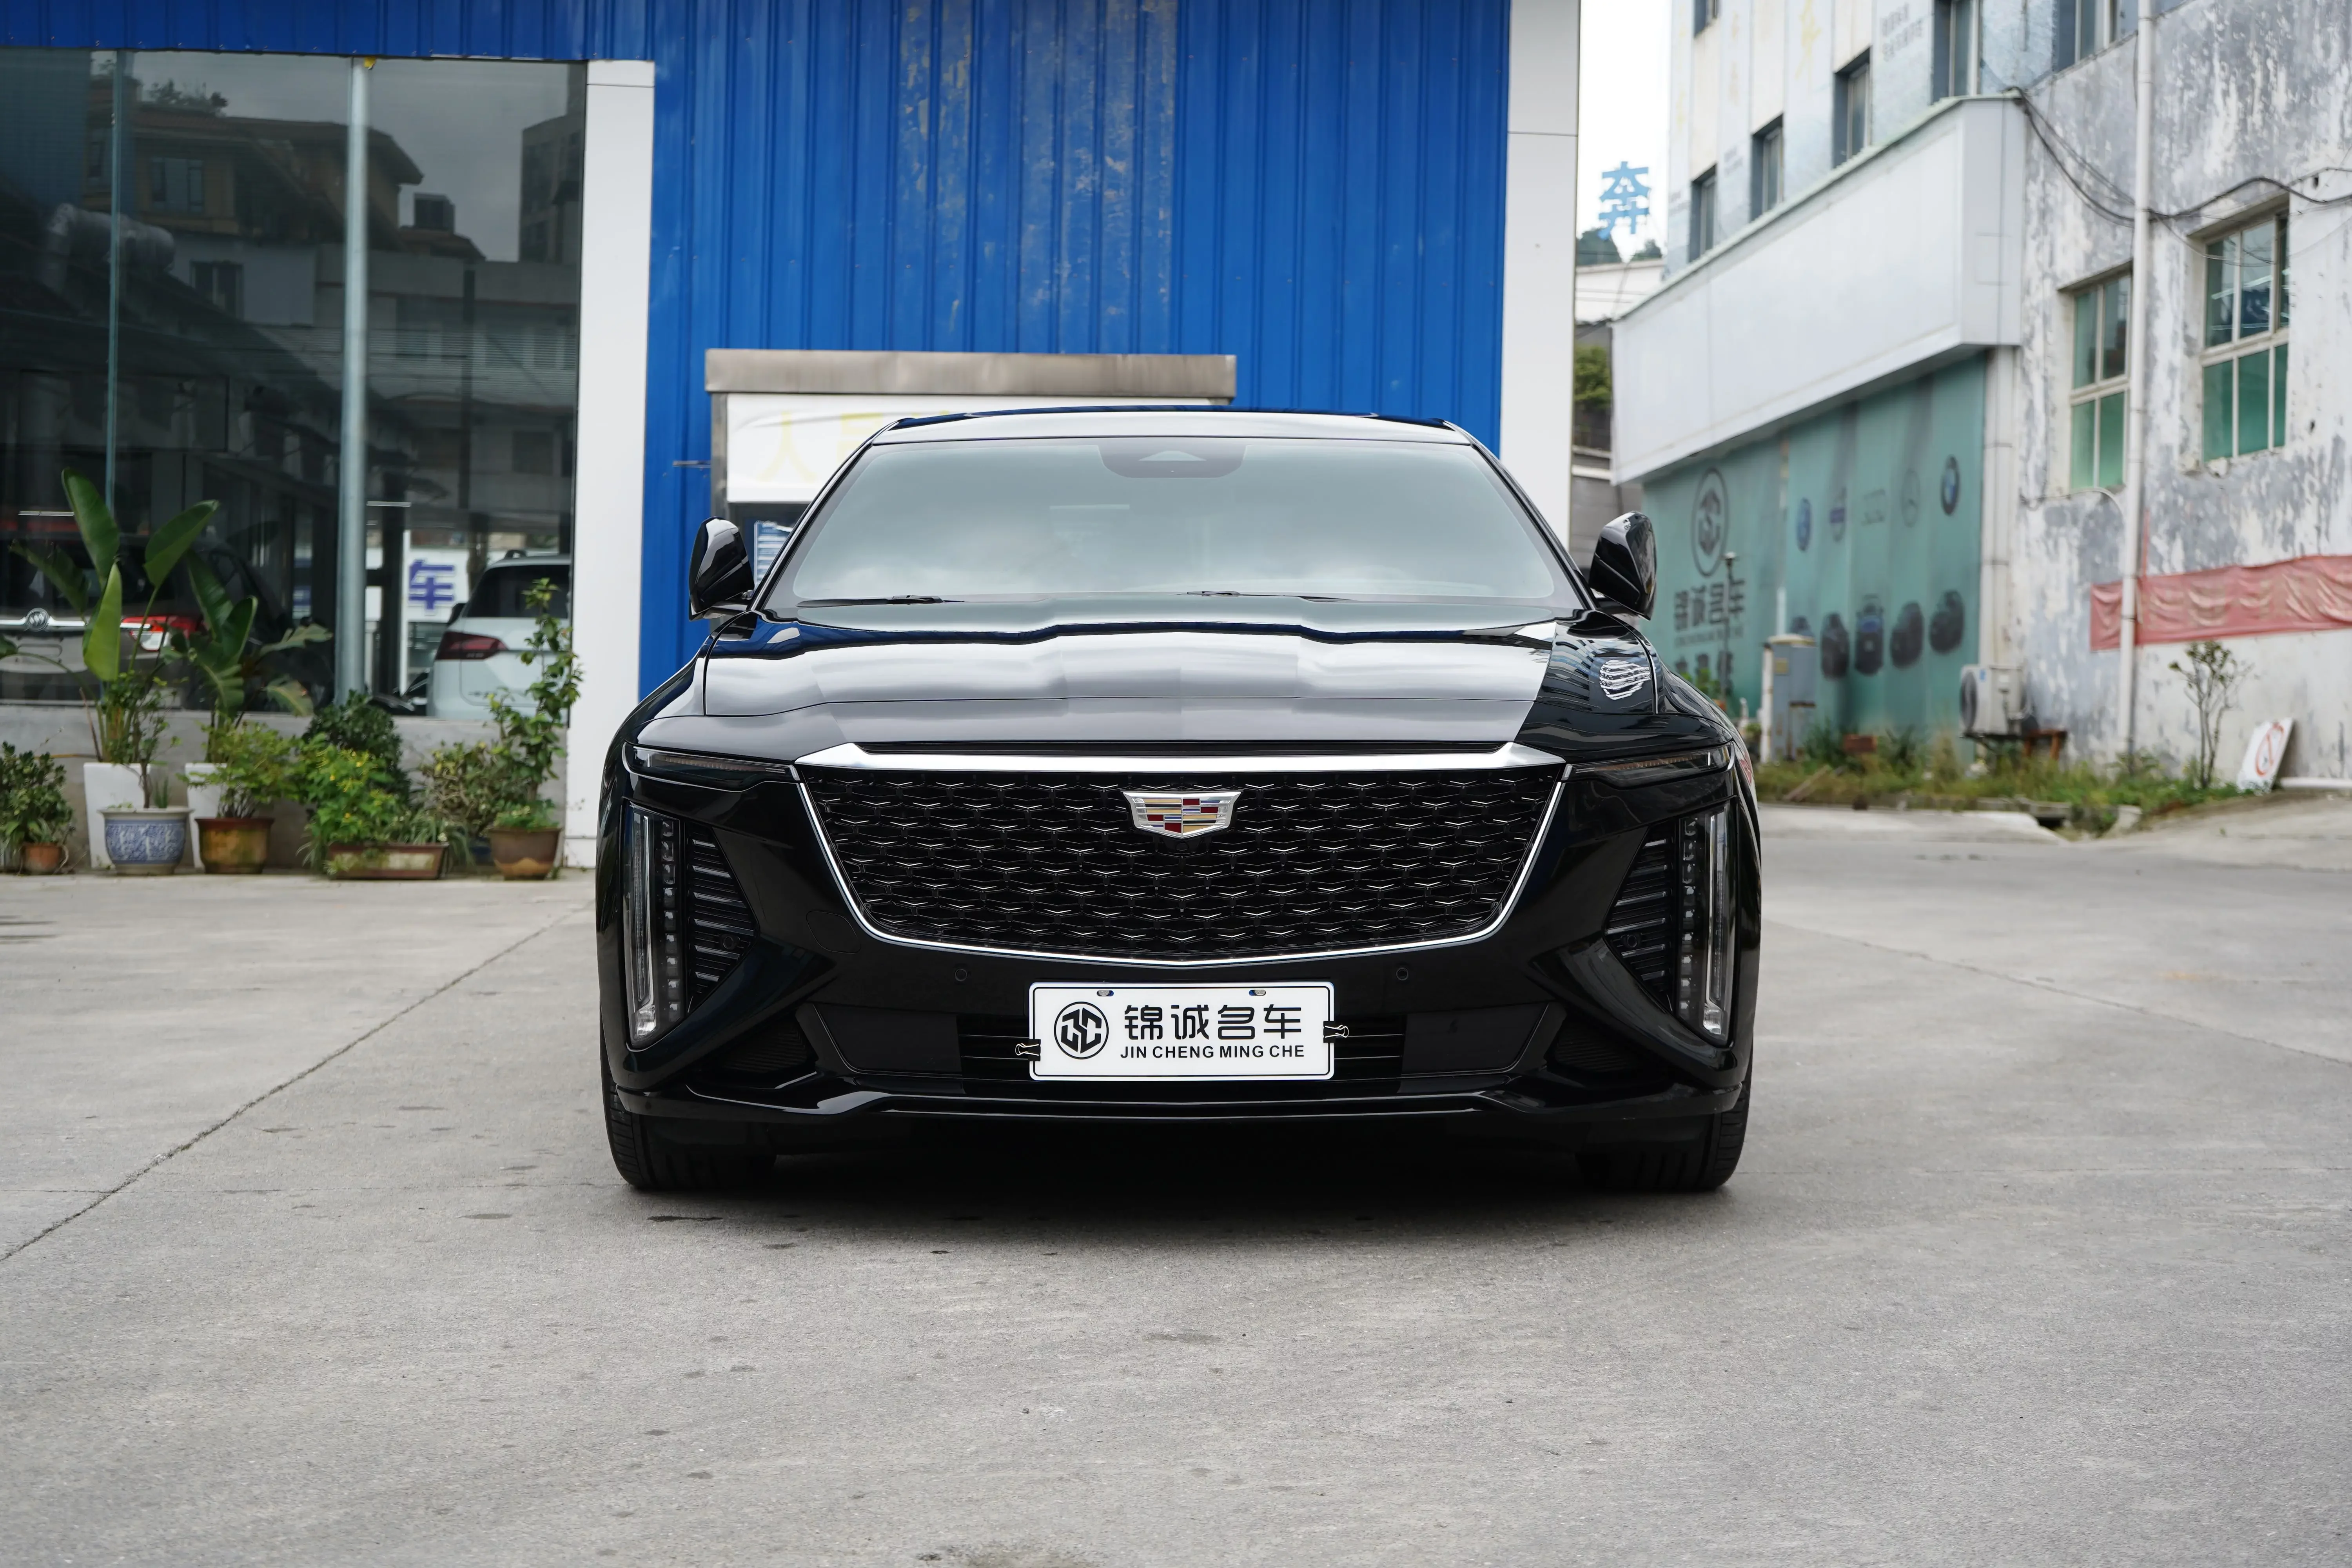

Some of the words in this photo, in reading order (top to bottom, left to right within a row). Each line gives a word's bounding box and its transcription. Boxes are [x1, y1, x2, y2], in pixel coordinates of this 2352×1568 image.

[1598, 161, 1651, 240] 奔
[1124, 1004, 1301, 1040] 锦诚名车
[1120, 1046, 1146, 1058] JIN
[1152, 1045, 1214, 1058] CHENG
[1220, 1045, 1263, 1058] MING
[1269, 1045, 1304, 1058] CHE
